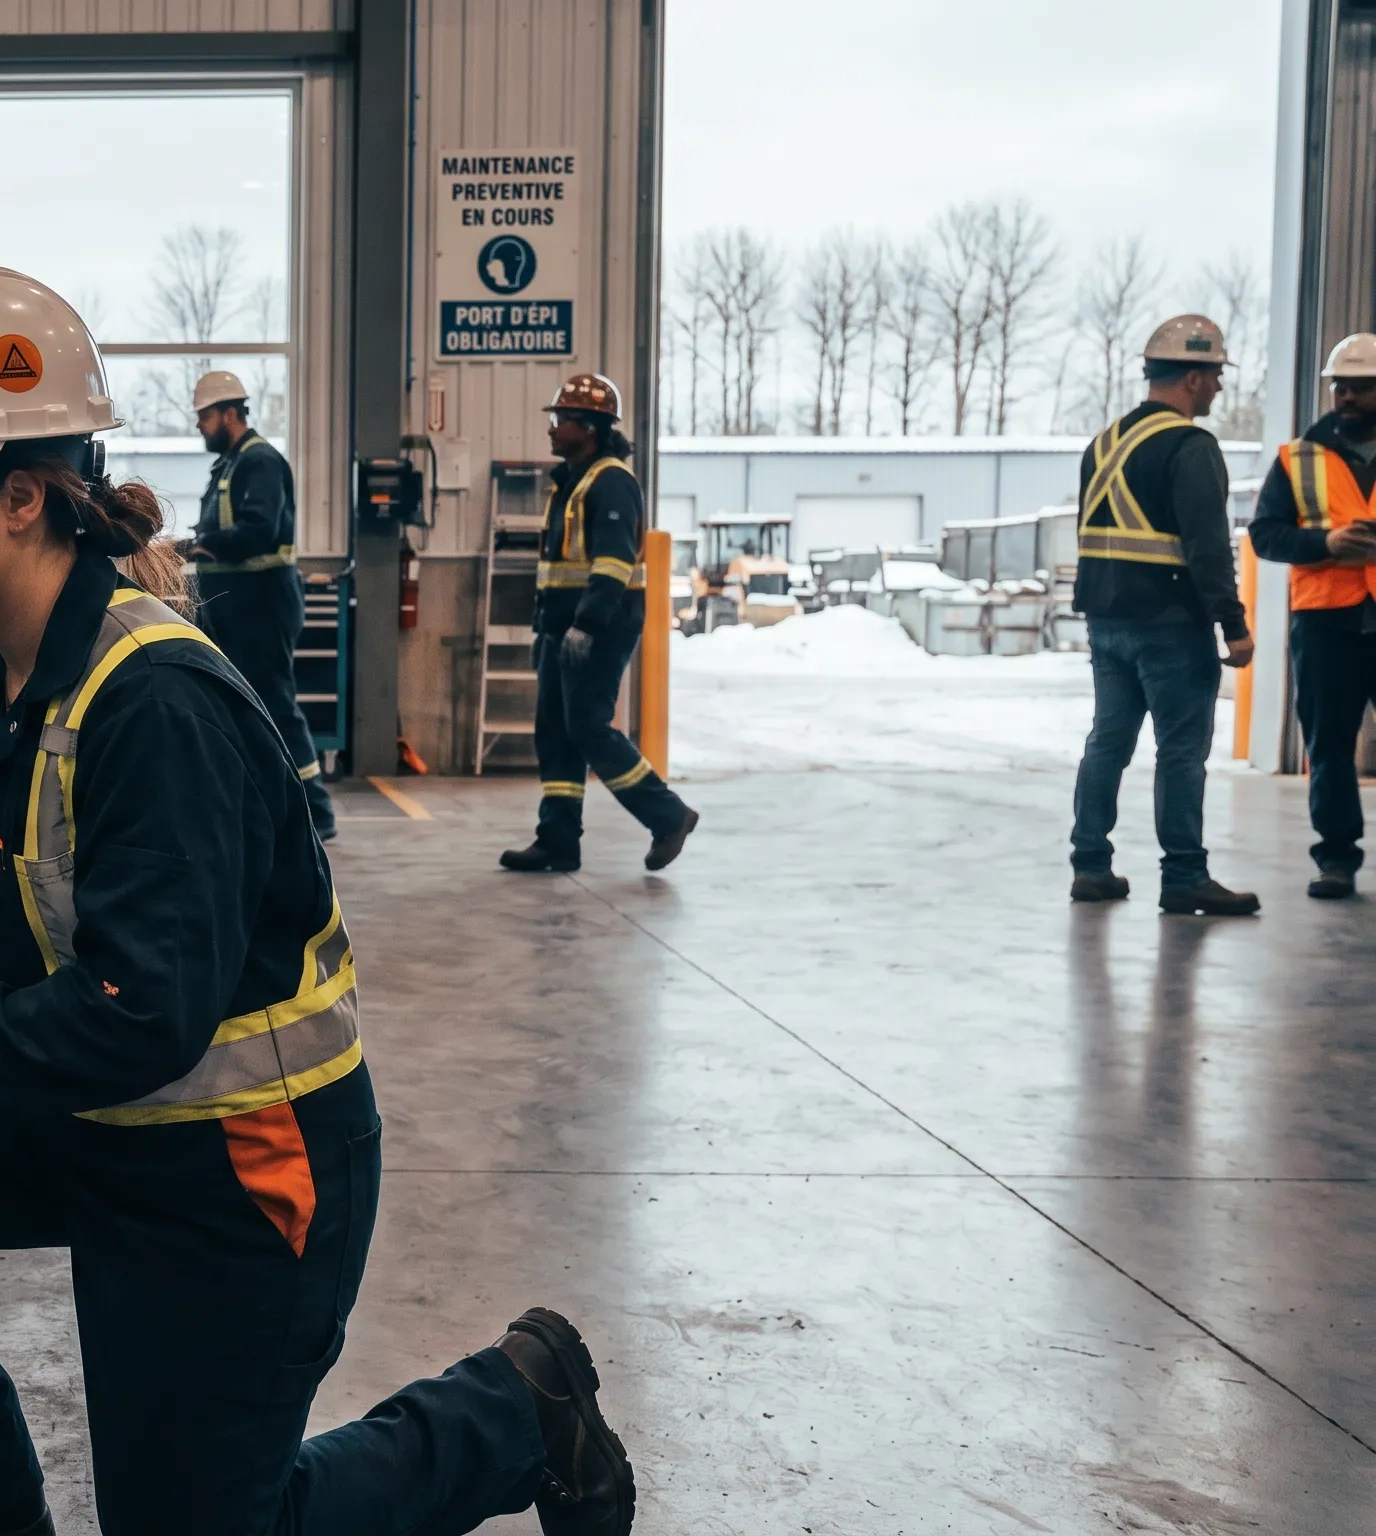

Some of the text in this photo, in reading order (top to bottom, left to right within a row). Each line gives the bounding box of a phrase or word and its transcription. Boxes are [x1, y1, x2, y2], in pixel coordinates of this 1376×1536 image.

[442, 156, 575, 175] MAINTENANCE
[462, 207, 554, 226] EN COURS
[455, 306, 505, 326] PORT
[446, 331, 566, 350] OBLIGATOIRE
